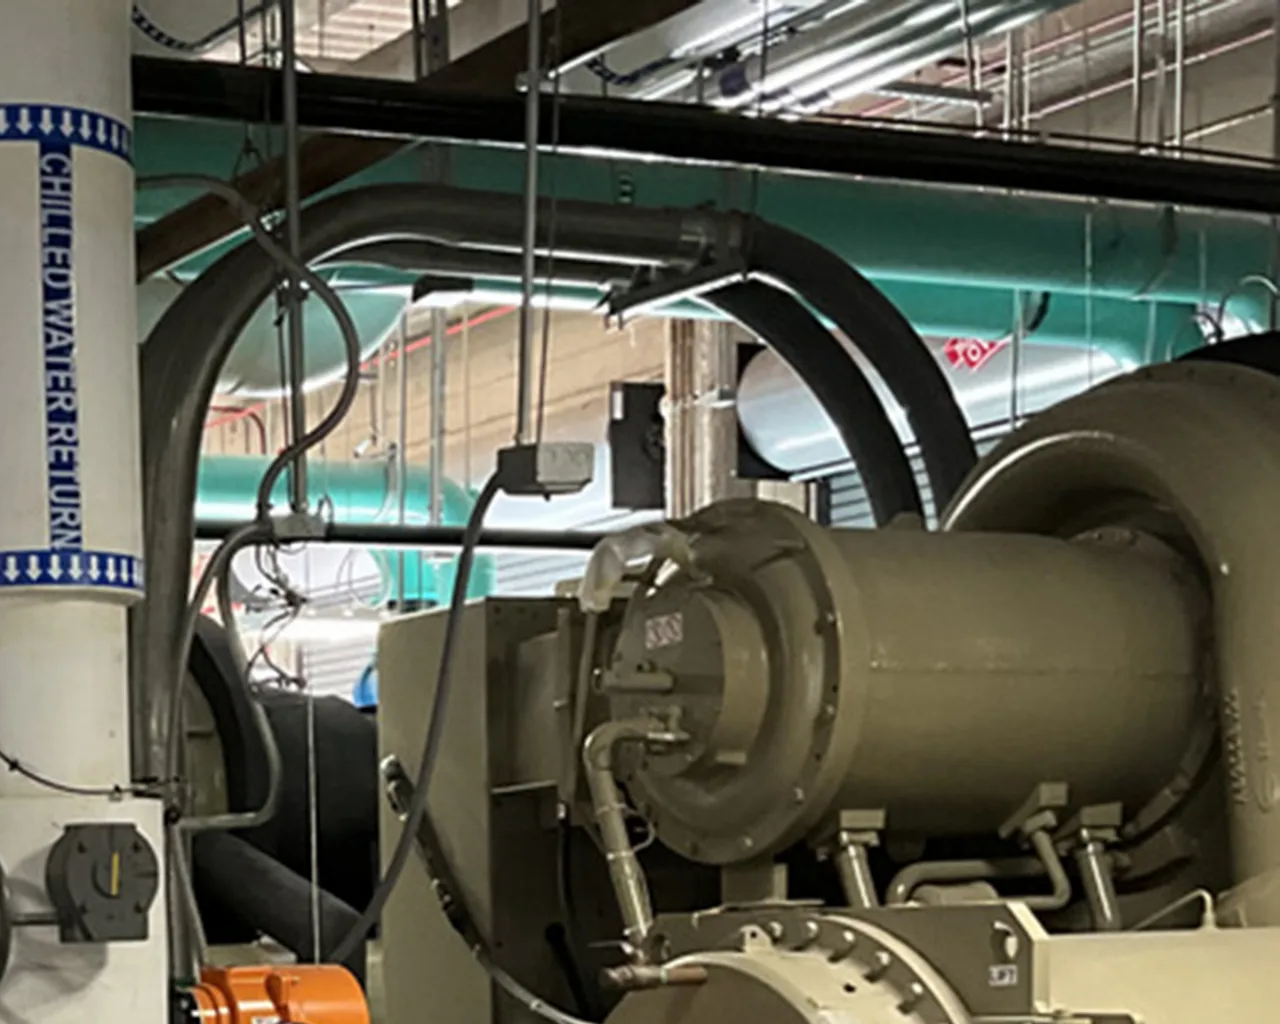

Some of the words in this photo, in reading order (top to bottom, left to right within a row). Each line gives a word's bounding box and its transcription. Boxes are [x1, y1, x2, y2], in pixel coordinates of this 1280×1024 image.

[40, 153, 73, 289] CHILLED
[44, 299, 78, 413] WATER
[47, 421, 83, 549] RETURN
